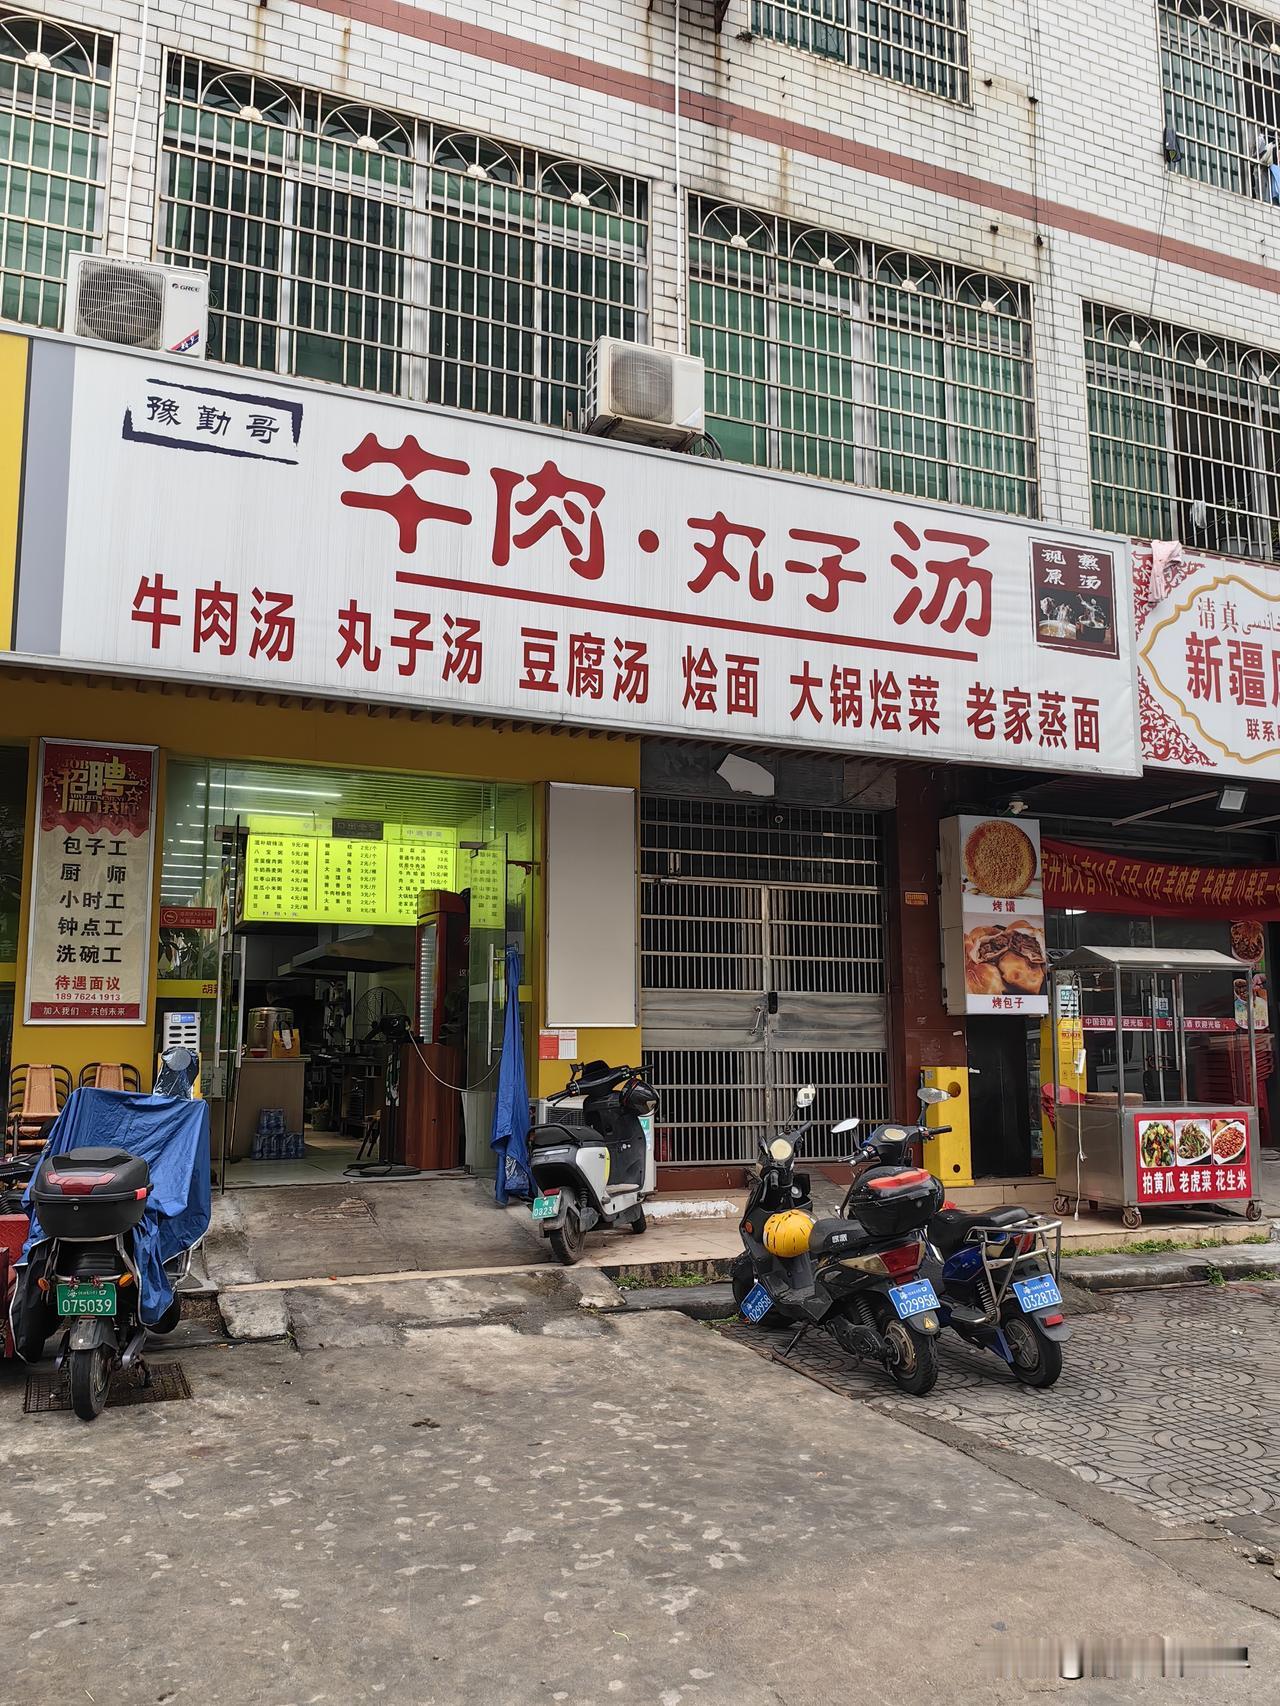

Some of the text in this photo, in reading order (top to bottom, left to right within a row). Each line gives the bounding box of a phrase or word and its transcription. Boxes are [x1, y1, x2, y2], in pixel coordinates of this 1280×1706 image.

[145, 396, 280, 445] 豫勤哥
[1197, 597, 1239, 634] 清真
[130, 573, 1100, 753] 牛肉汤 丸子汤 豆腐汤 烩面 大锅烩菜 老家蒸面
[1185, 631, 1280, 708] 新疆
[1246, 718, 1280, 742] 联系
[56, 756, 140, 814] 招聘
[63, 836, 127, 856] 包子工
[60, 864, 127, 885] 厨师
[59, 890, 125, 910] 小时工
[57, 917, 123, 937] 钟点工
[56, 944, 122, 964] 洗碗工
[55, 974, 121, 991] 待遇面议
[55, 992, 121, 1001] 189 7624 1913
[991, 997, 1024, 1009] 烤包子
[43, 1006, 126, 1017] 加入我们 共创未来
[1142, 1169, 1247, 1194] 拍黄瓜 老虎菜 花生米
[62, 1299, 112, 1313] 075039
[749, 1294, 772, 1322] 029958
[899, 1293, 937, 1315] 029958
[1022, 1288, 1059, 1309] 032873
